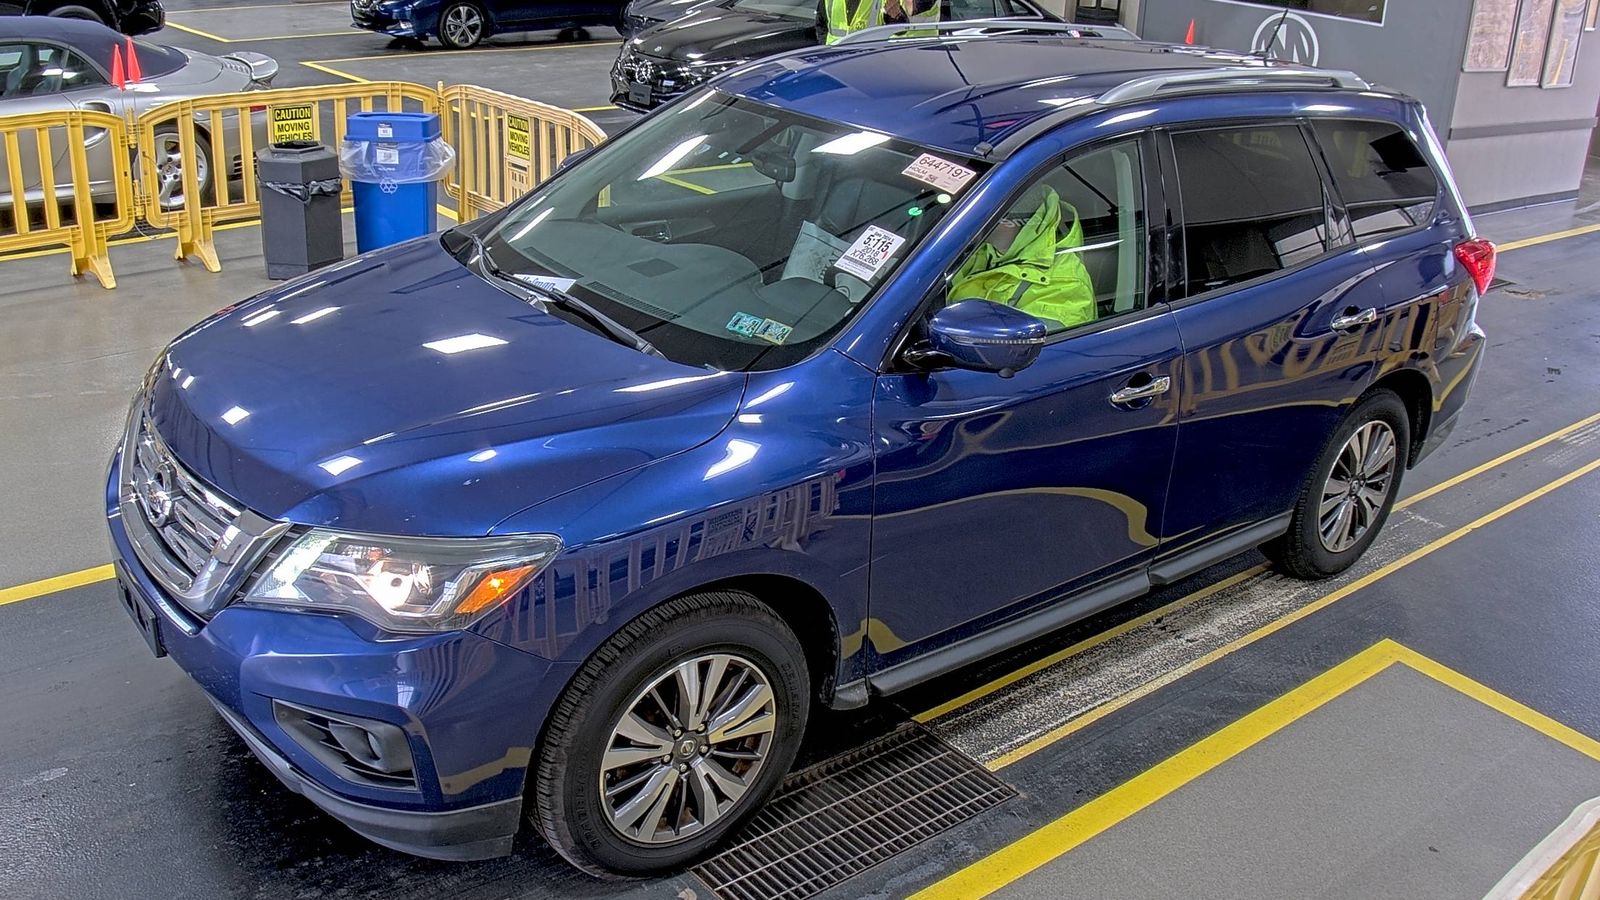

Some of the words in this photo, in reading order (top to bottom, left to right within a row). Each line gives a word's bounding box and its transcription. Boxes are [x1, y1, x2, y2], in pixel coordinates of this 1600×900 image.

[275, 107, 311, 121] CAUTION
[277, 121, 310, 133] MOVING
[508, 115, 529, 132] CAUTION
[274, 132, 313, 142] VEHICLES
[509, 130, 528, 144] MOVING
[509, 142, 529, 156] VEHICLES
[919, 156, 971, 180] 6447197
[863, 234, 893, 252] 5:115
[861, 245, 881, 257] 2018
